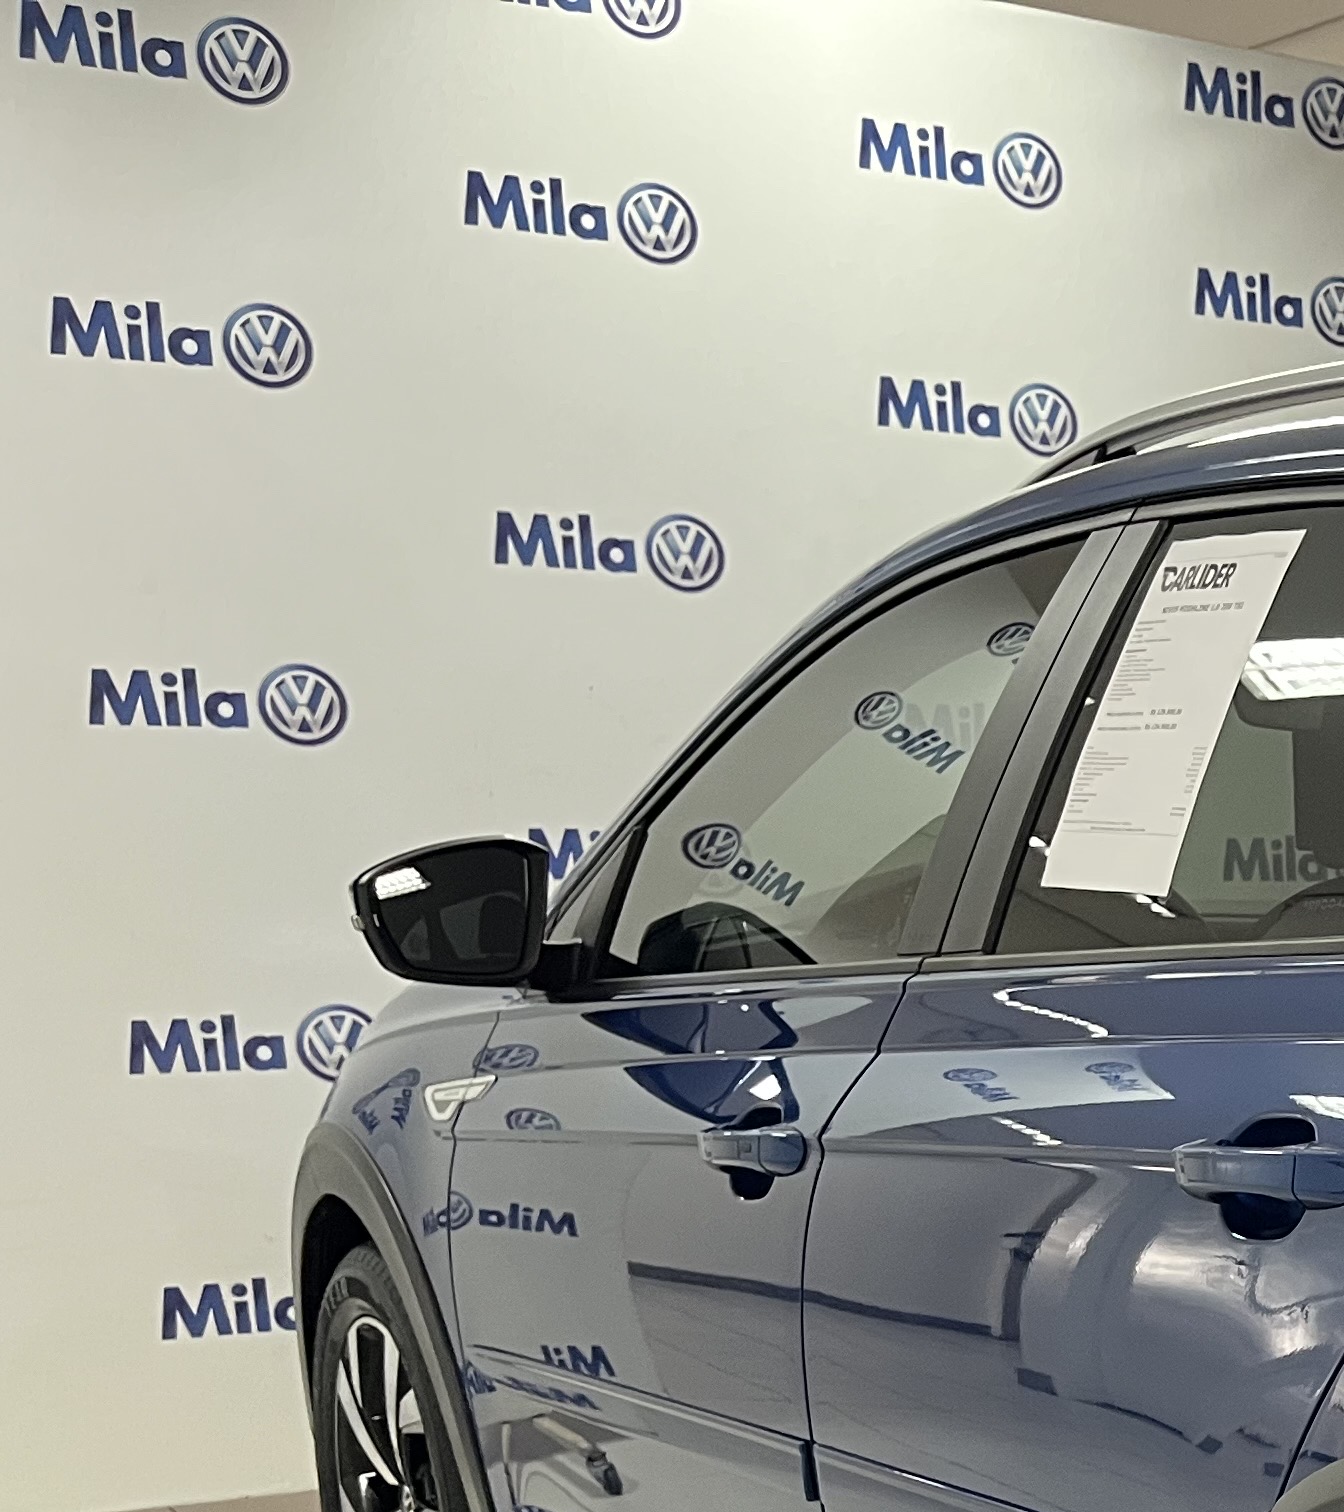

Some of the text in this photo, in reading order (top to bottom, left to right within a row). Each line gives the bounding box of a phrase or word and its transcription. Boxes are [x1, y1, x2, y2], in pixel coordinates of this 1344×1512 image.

[20, 0, 188, 79] Mila
[1184, 62, 1295, 130] Mila
[858, 118, 984, 188] Mila
[464, 170, 608, 241] Mila
[1194, 268, 1303, 329] Mila
[51, 296, 213, 366] Mila
[877, 376, 1001, 438] Mila
[494, 511, 637, 573] Mila
[1161, 562, 1238, 592] CARLIDER
[88, 668, 249, 728] Mila
[129, 1014, 287, 1075] Mila
